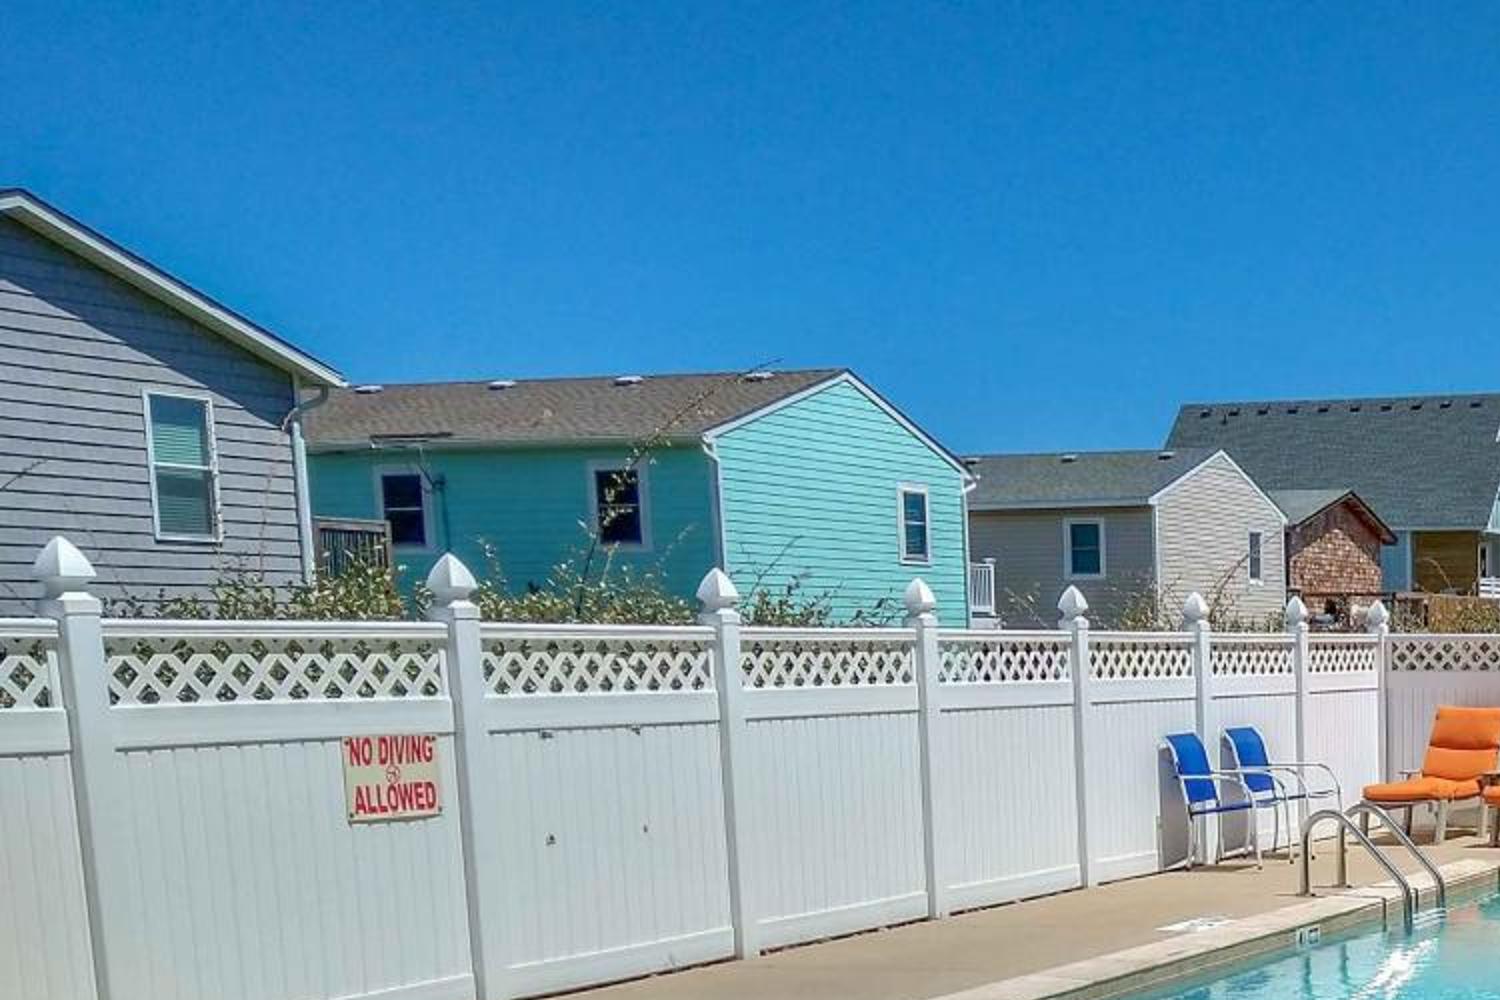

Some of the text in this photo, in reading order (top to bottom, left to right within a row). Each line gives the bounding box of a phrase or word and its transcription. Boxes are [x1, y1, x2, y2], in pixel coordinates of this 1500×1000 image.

[349, 735, 433, 767] NO DIVING
[355, 781, 437, 814] ALLOWED
